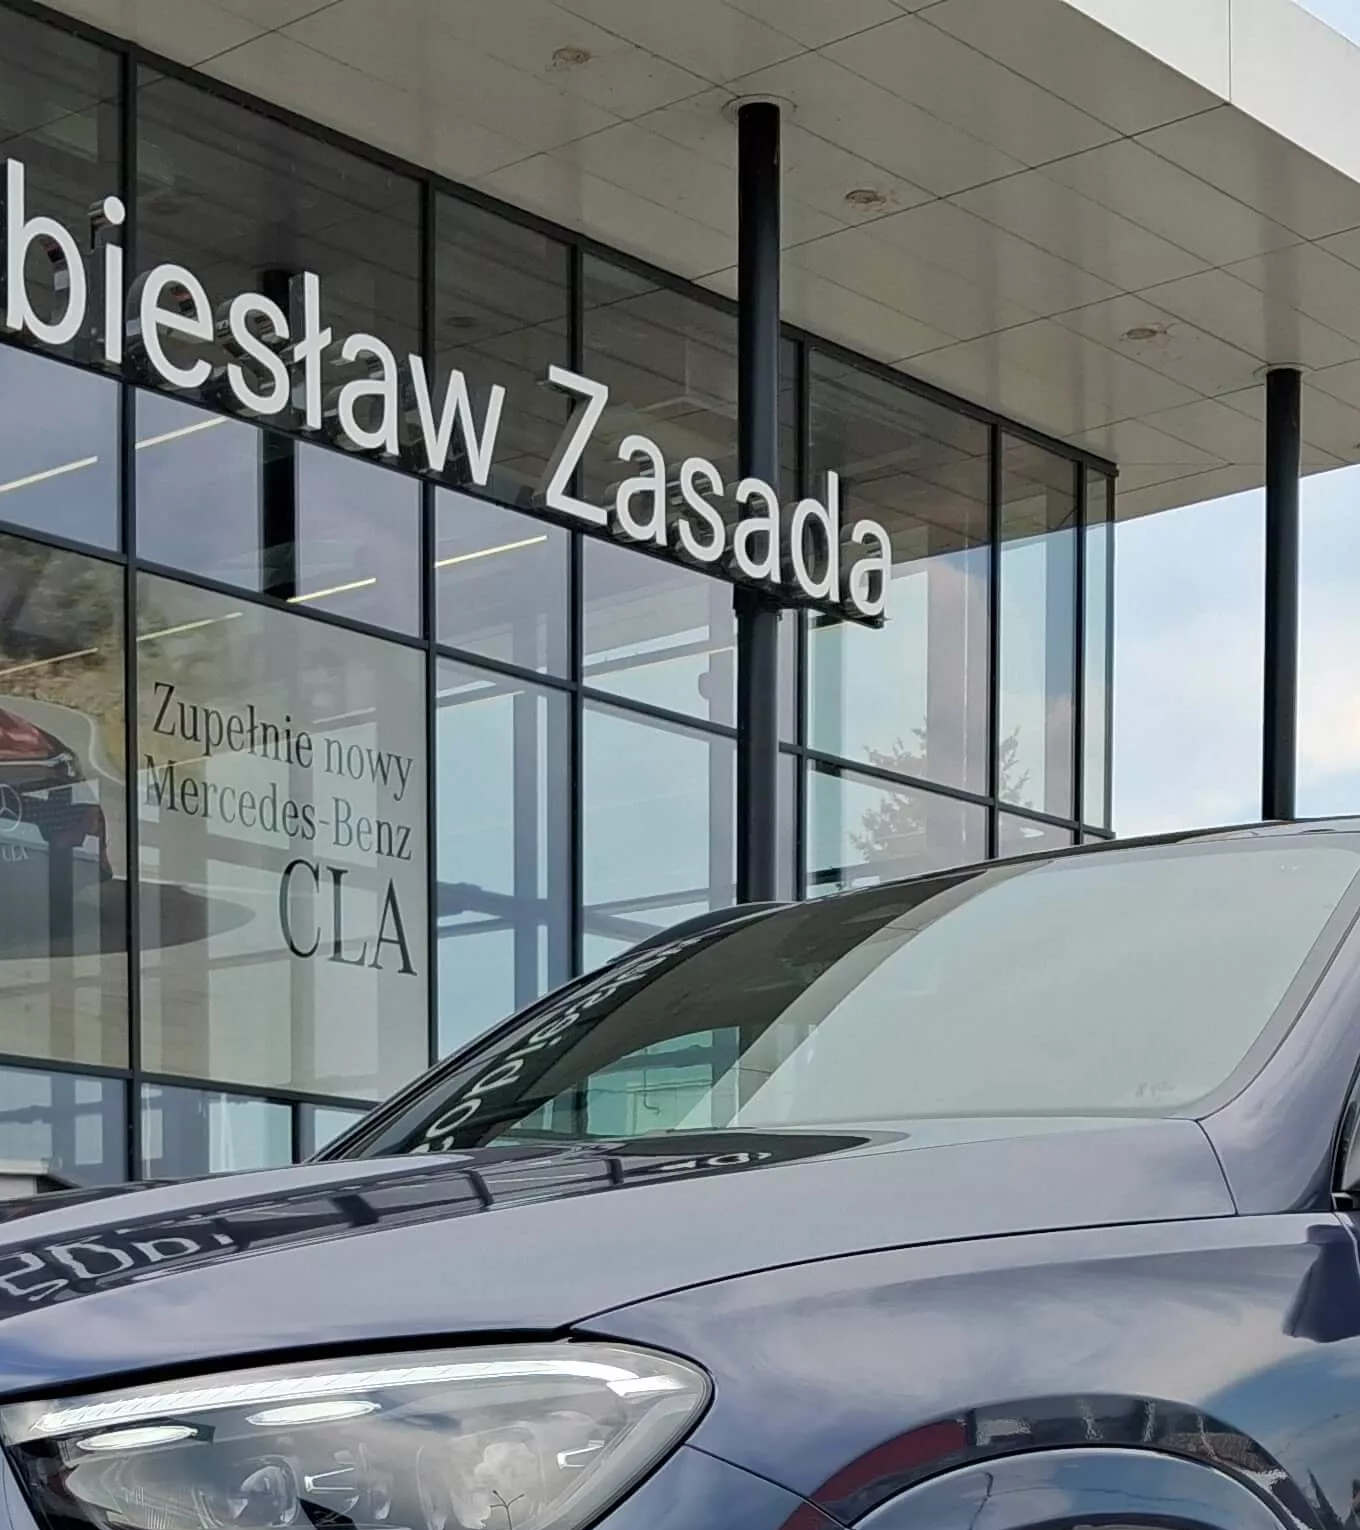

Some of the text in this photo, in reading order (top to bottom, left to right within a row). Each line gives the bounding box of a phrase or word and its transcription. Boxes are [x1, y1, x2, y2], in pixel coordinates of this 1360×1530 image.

[545, 363, 892, 616] Zasada
[152, 681, 414, 802] Zupełnie nowy
[143, 753, 413, 861] Mercedes-Benz
[279, 858, 418, 977] CLA
